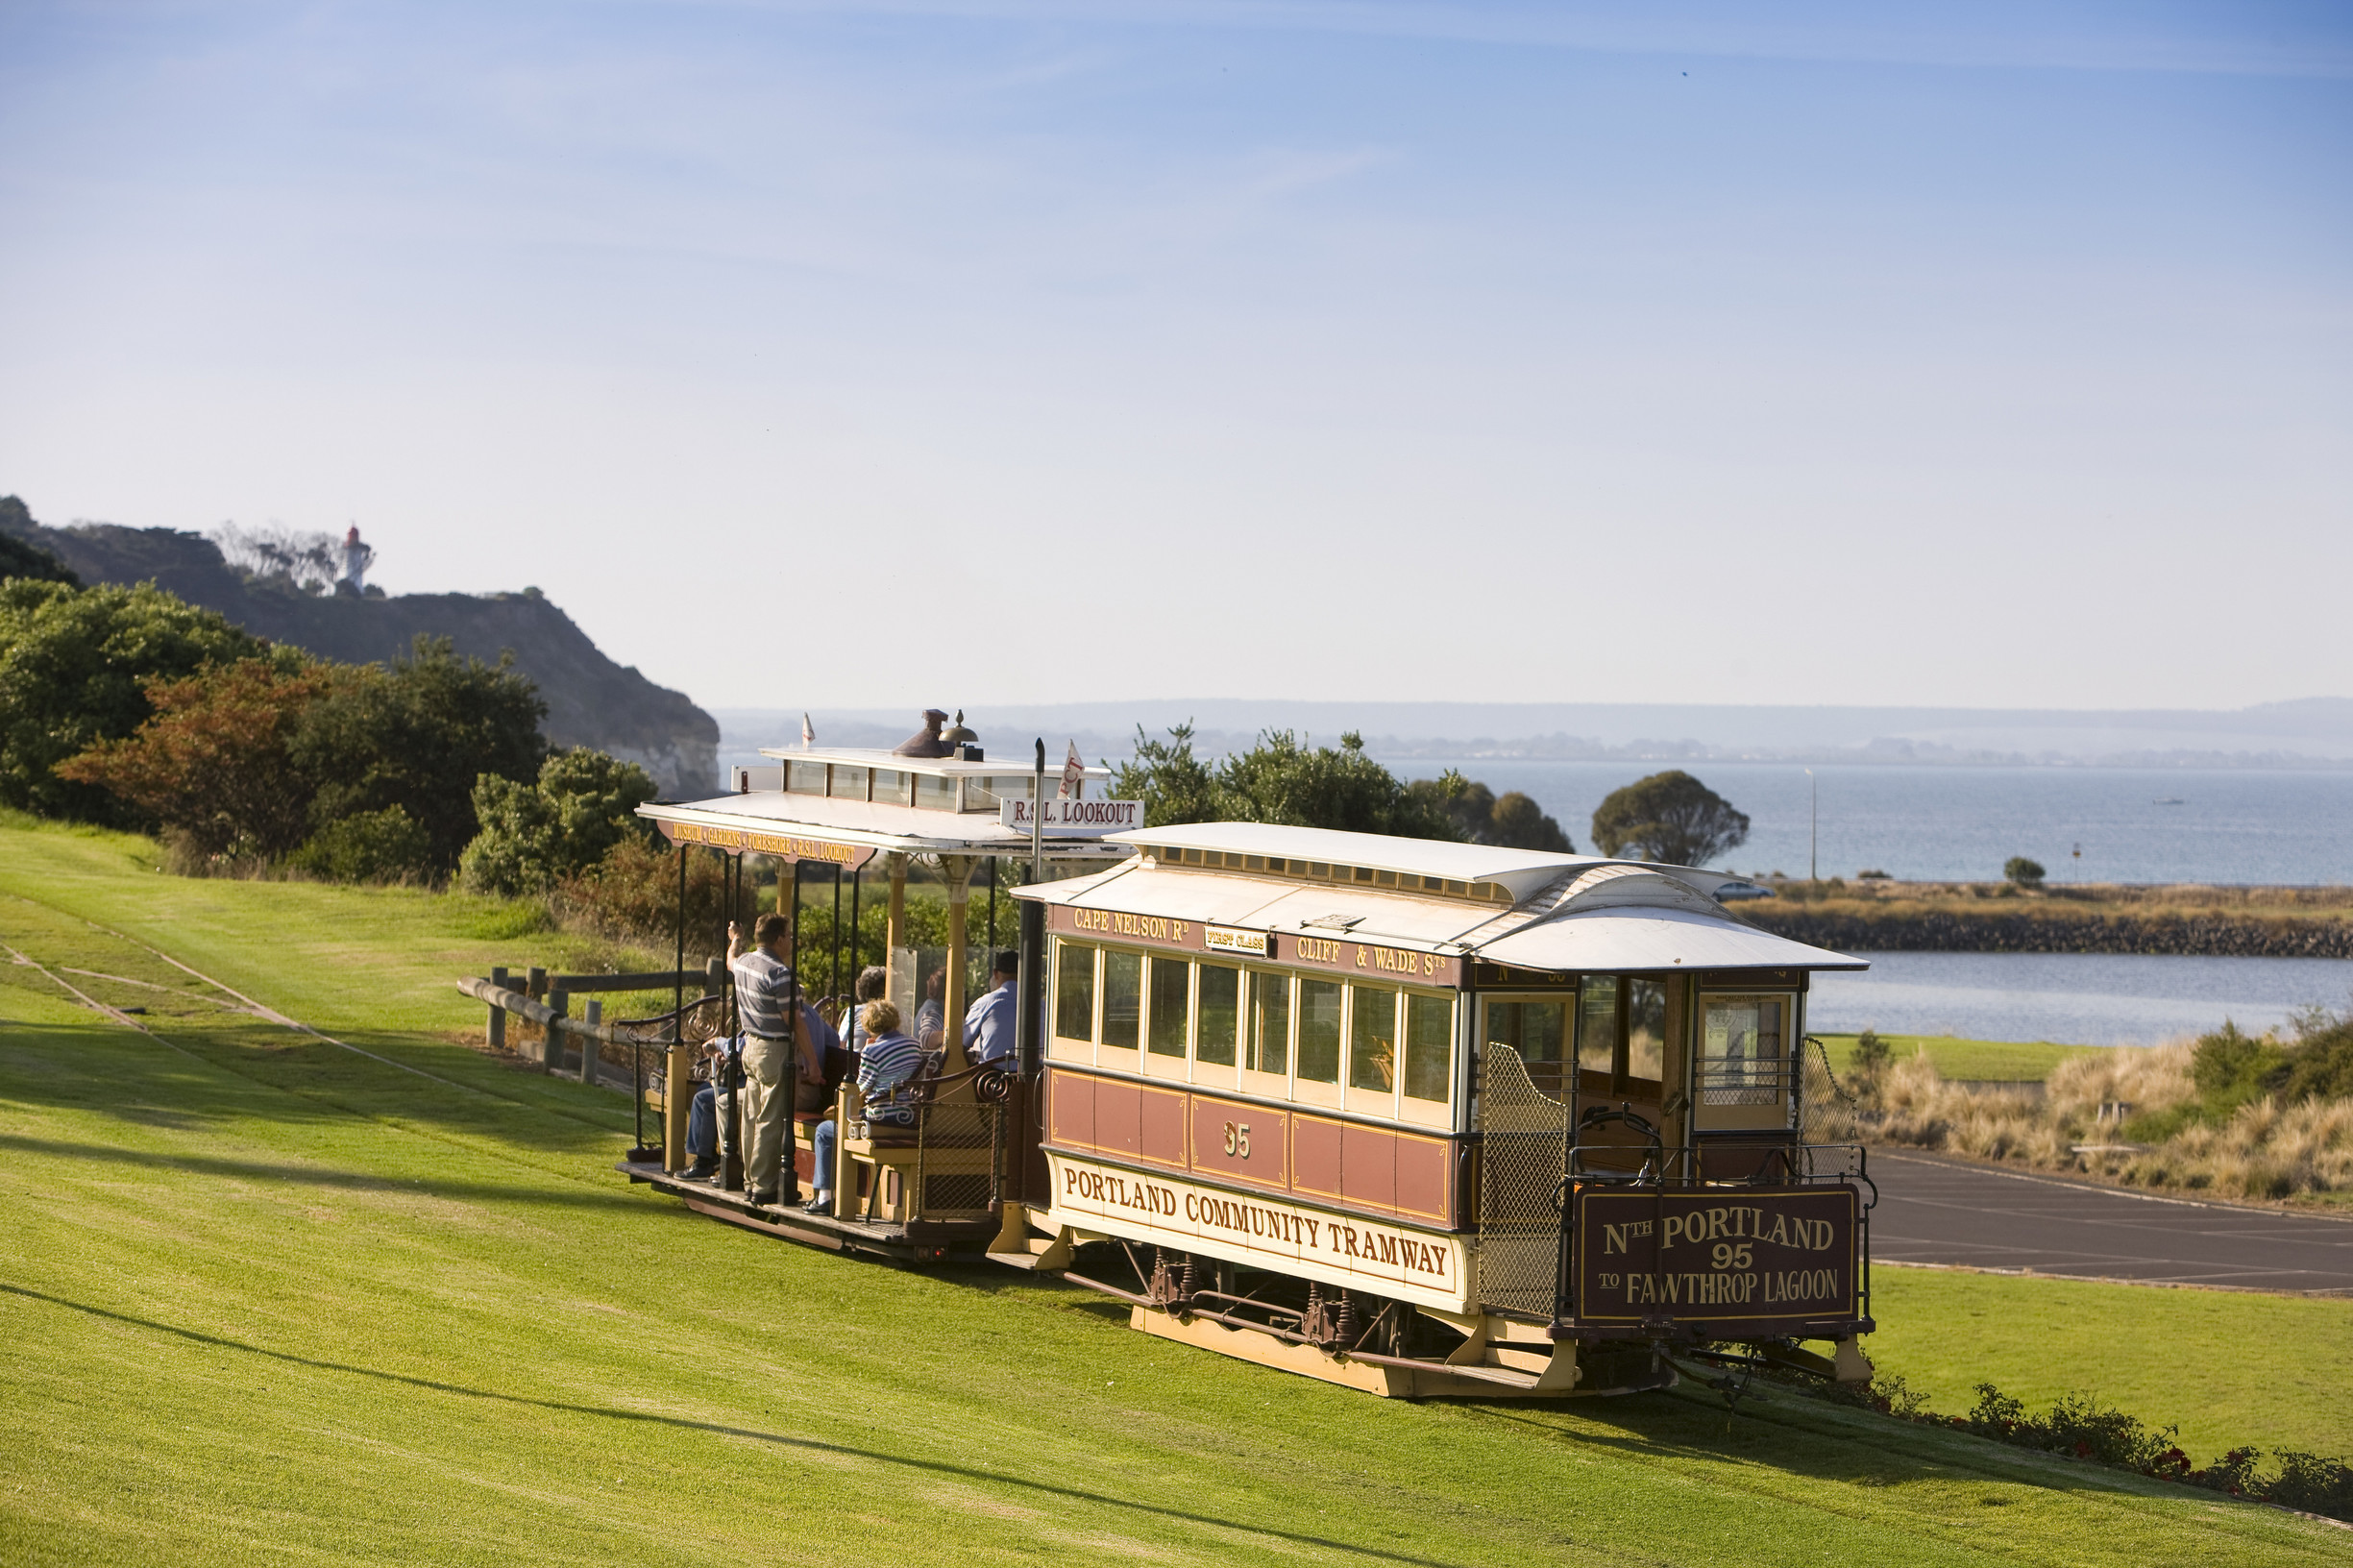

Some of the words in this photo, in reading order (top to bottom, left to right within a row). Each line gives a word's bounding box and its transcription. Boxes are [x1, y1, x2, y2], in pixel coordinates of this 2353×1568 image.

[1015, 801, 1057, 822] R.L.
[1064, 802, 1136, 823] LOOKOUT
[673, 822, 702, 843] MUSEUM
[708, 828, 741, 848] GARDENS
[748, 833, 791, 856] FORESHORE
[797, 839, 818, 859] R.S.L.
[820, 843, 855, 864] LOOKOUT
[1074, 908, 1109, 931] CAPE
[1114, 912, 1167, 940] NELSON
[1207, 930, 1234, 946] FIRST
[1236, 934, 1264, 950] CLASS
[1297, 937, 1340, 963] CLIFF
[1356, 944, 1367, 968] &
[1374, 946, 1417, 974] WADE
[1224, 1120, 1250, 1159] 95
[1065, 1167, 1177, 1217] PORTLAND
[1186, 1193, 1319, 1248] COMMUNITY
[1328, 1223, 1447, 1277] TRAMWAY
[1661, 1206, 1834, 1251] PORTLAND
[1711, 1242, 1753, 1270] 95
[1599, 1273, 1620, 1288] TO
[1627, 1273, 1758, 1305] FAWTHROP
[1765, 1269, 1838, 1302] LAGOON
